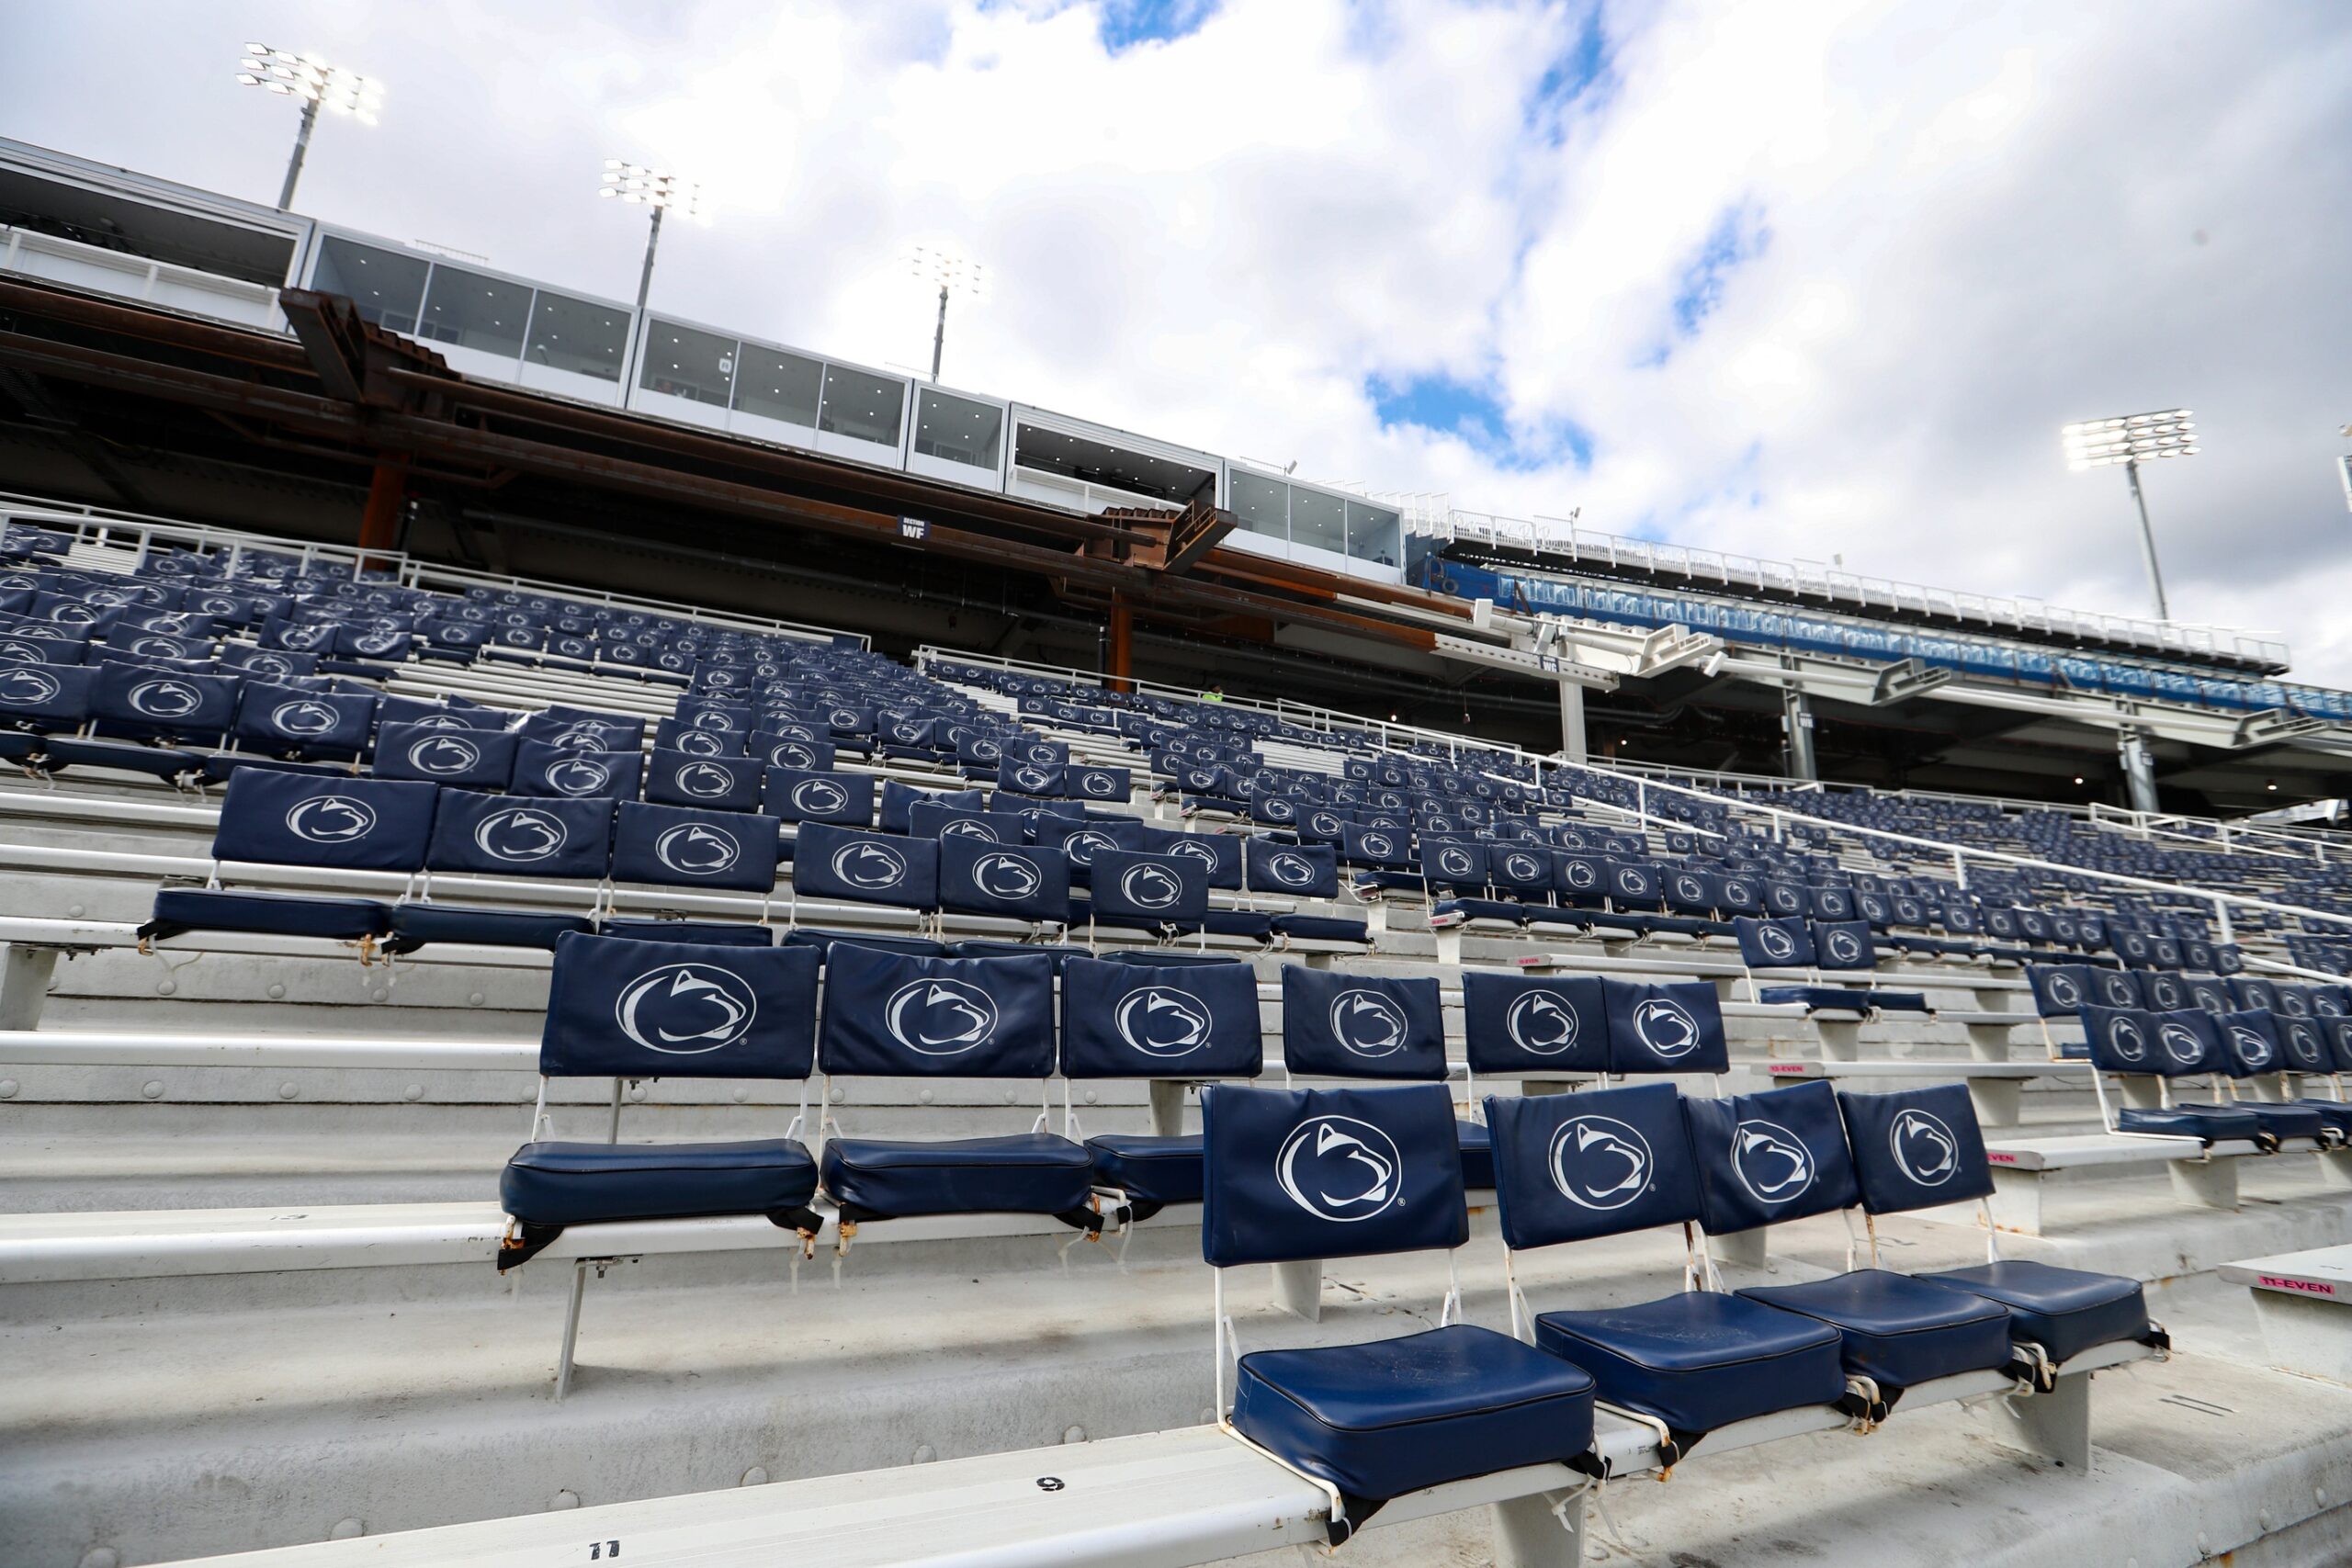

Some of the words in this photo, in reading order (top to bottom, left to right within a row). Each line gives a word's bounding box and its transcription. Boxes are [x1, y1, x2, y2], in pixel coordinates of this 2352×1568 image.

[903, 516, 925, 527] SECTION
[902, 525, 925, 539] WF
[1543, 660, 1557, 673] WG
[2256, 1275, 2332, 1294] 11-EVEN
[1035, 1476, 1066, 1492] 9
[588, 1540, 620, 1561] 11
